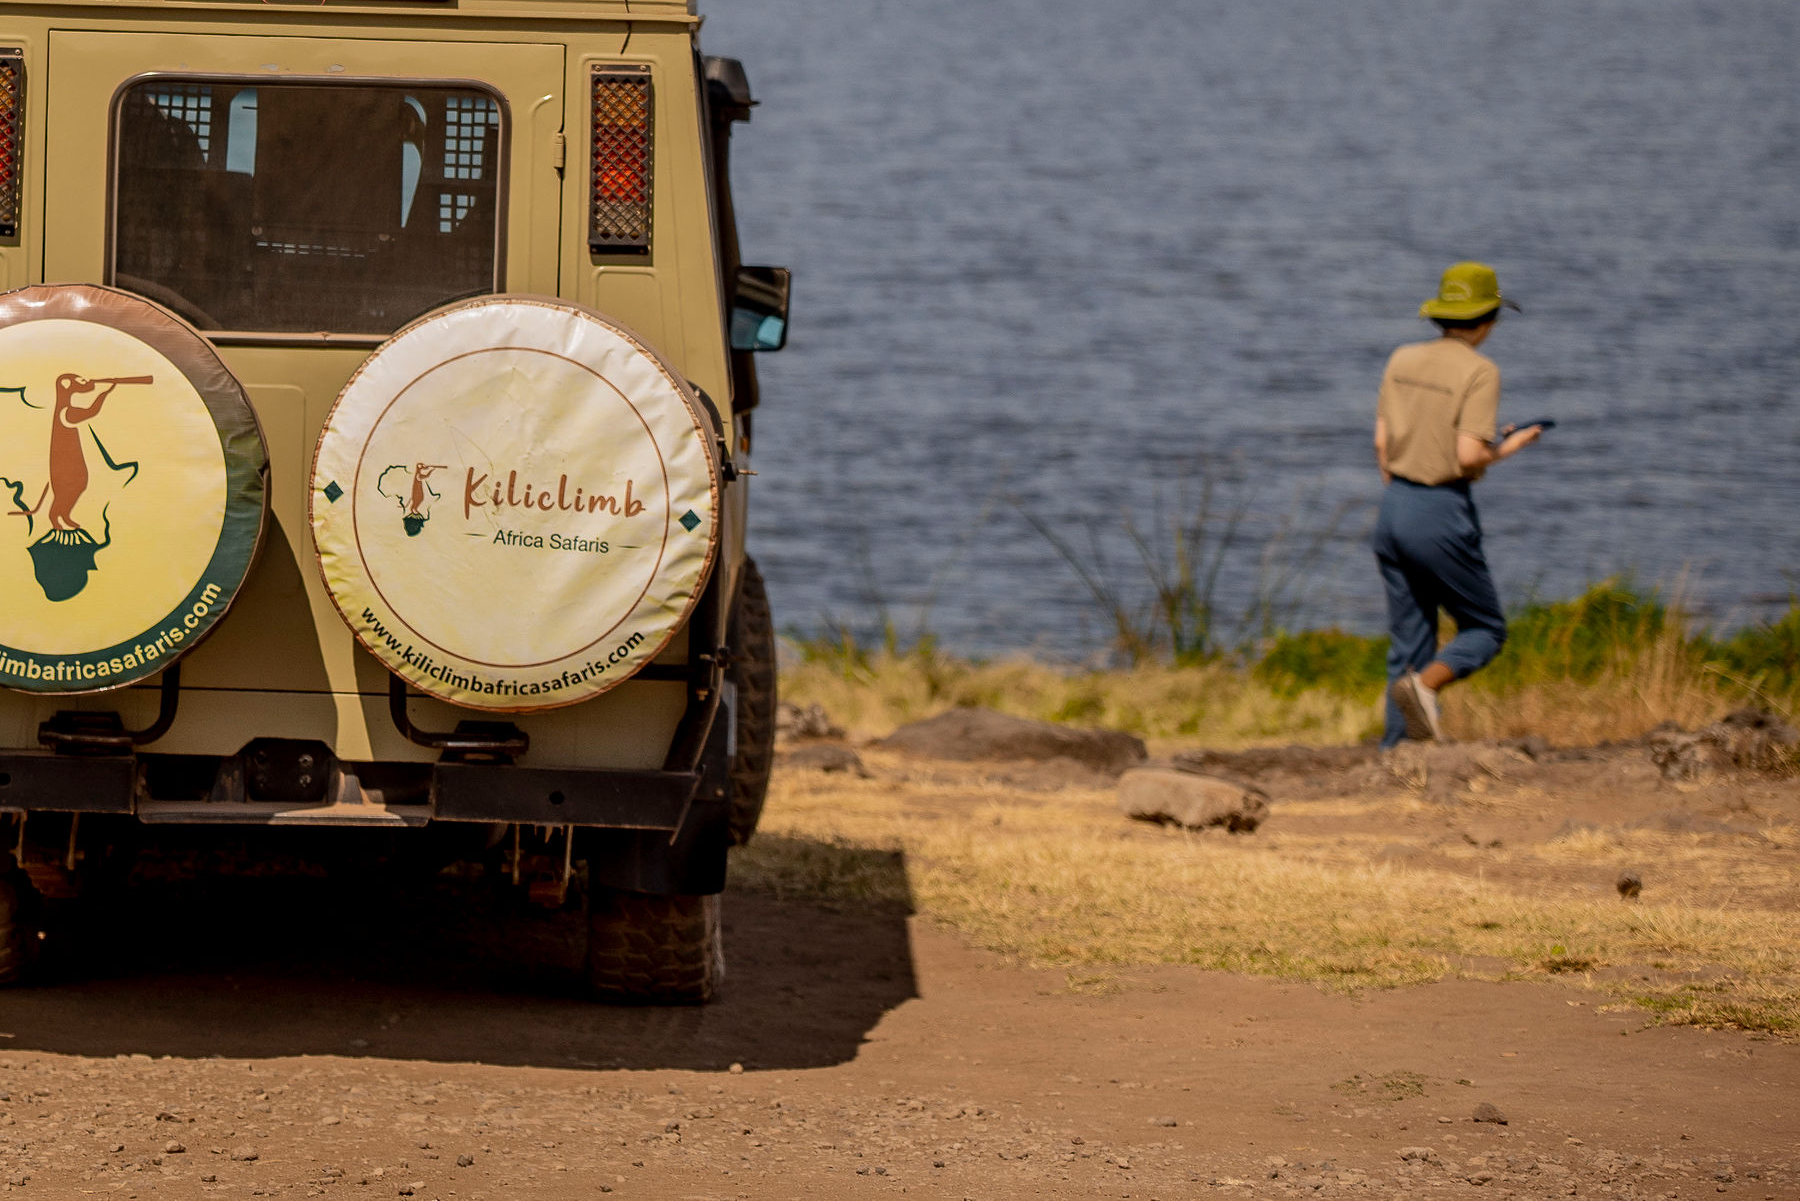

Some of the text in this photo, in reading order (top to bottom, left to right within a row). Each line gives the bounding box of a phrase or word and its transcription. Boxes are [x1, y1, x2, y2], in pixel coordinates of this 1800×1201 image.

[463, 466, 647, 520] Kiliclimb
[492, 528, 610, 554] Africa Safaris
[361, 606, 646, 697] www.kiliclimbafricasafaris.com
